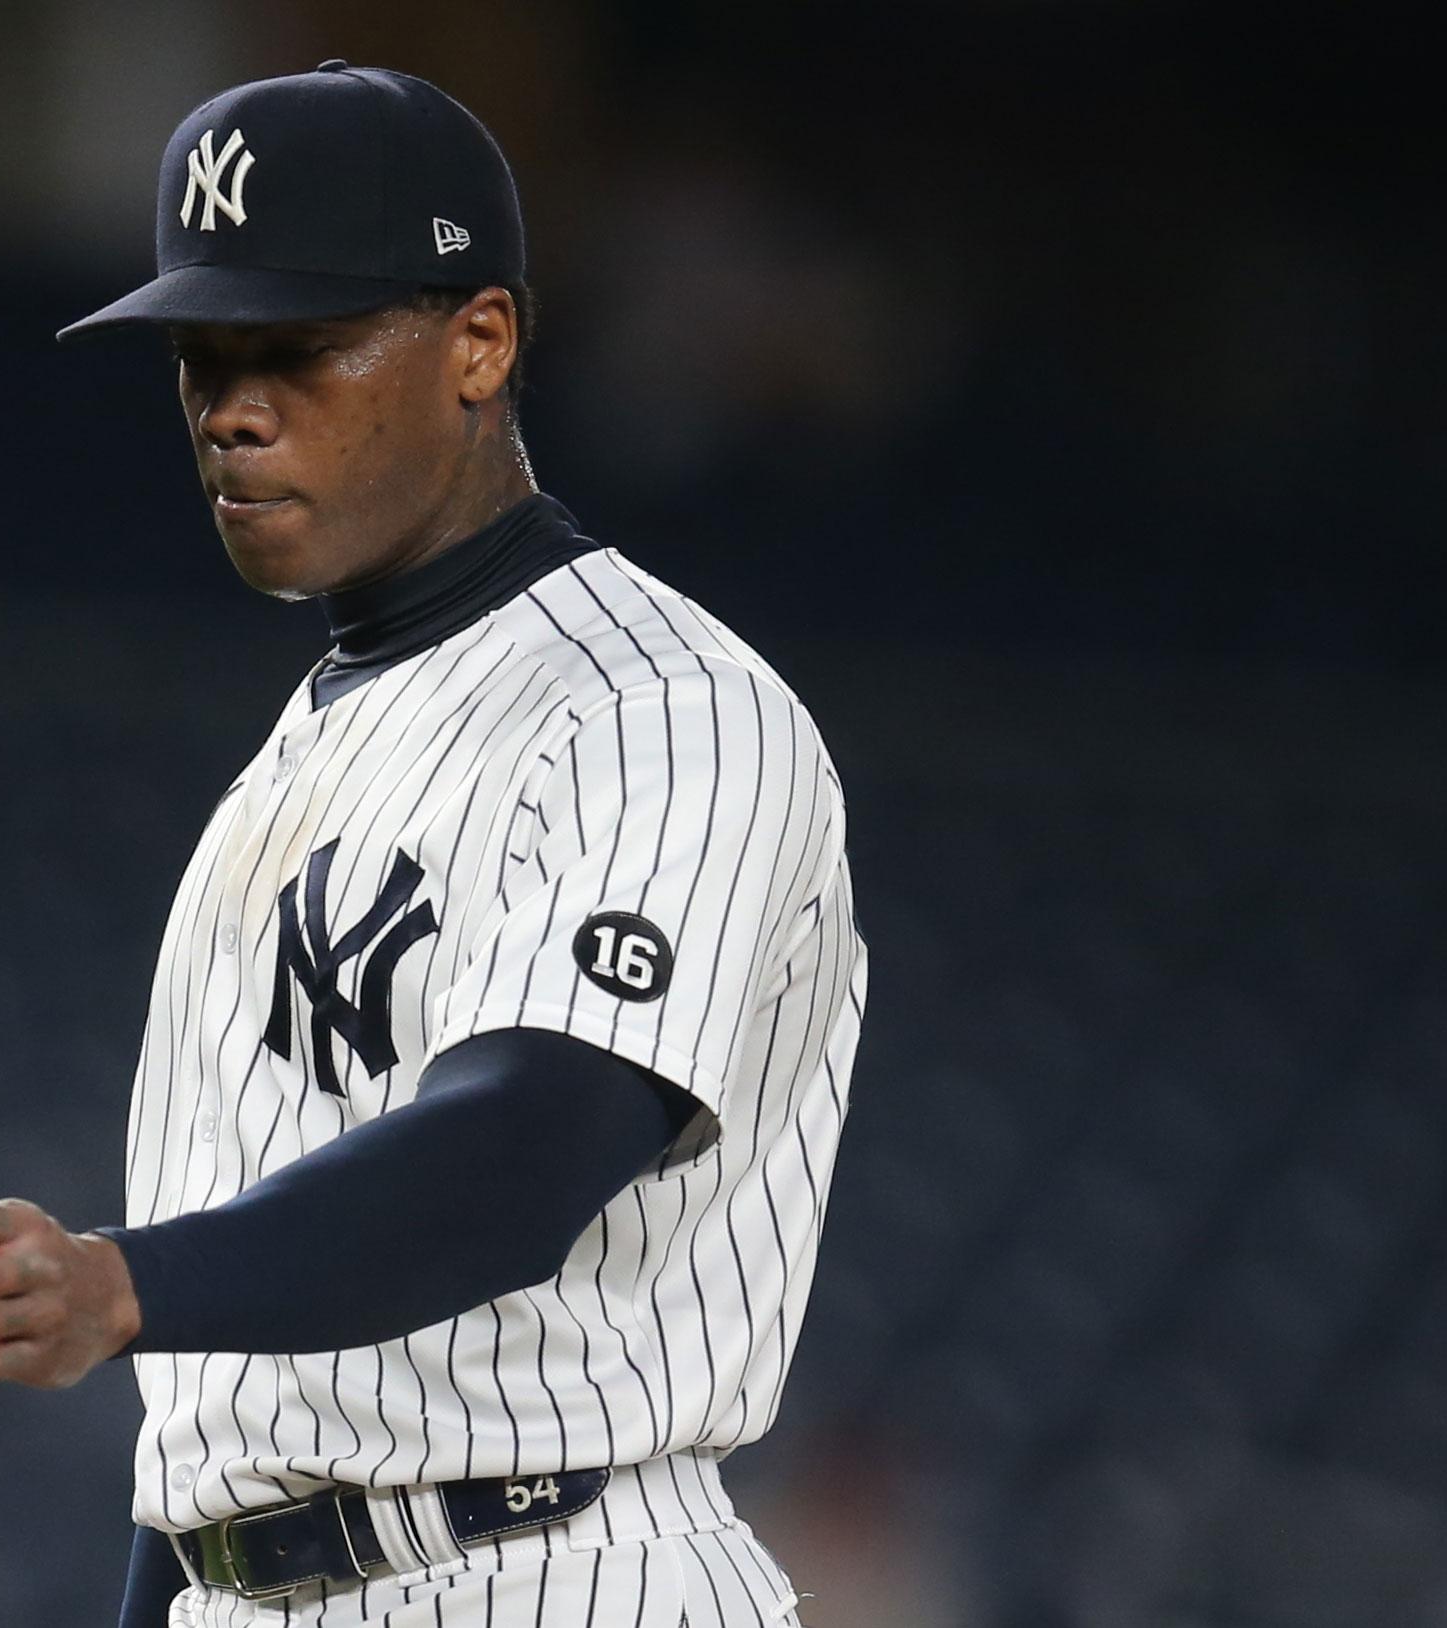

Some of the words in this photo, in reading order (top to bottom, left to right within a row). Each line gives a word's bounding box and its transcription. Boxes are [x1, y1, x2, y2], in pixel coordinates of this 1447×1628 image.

[180, 128, 256, 231] NY
[262, 836, 440, 1099] NY
[591, 925, 658, 990] 16
[505, 1476, 560, 1513] 54
